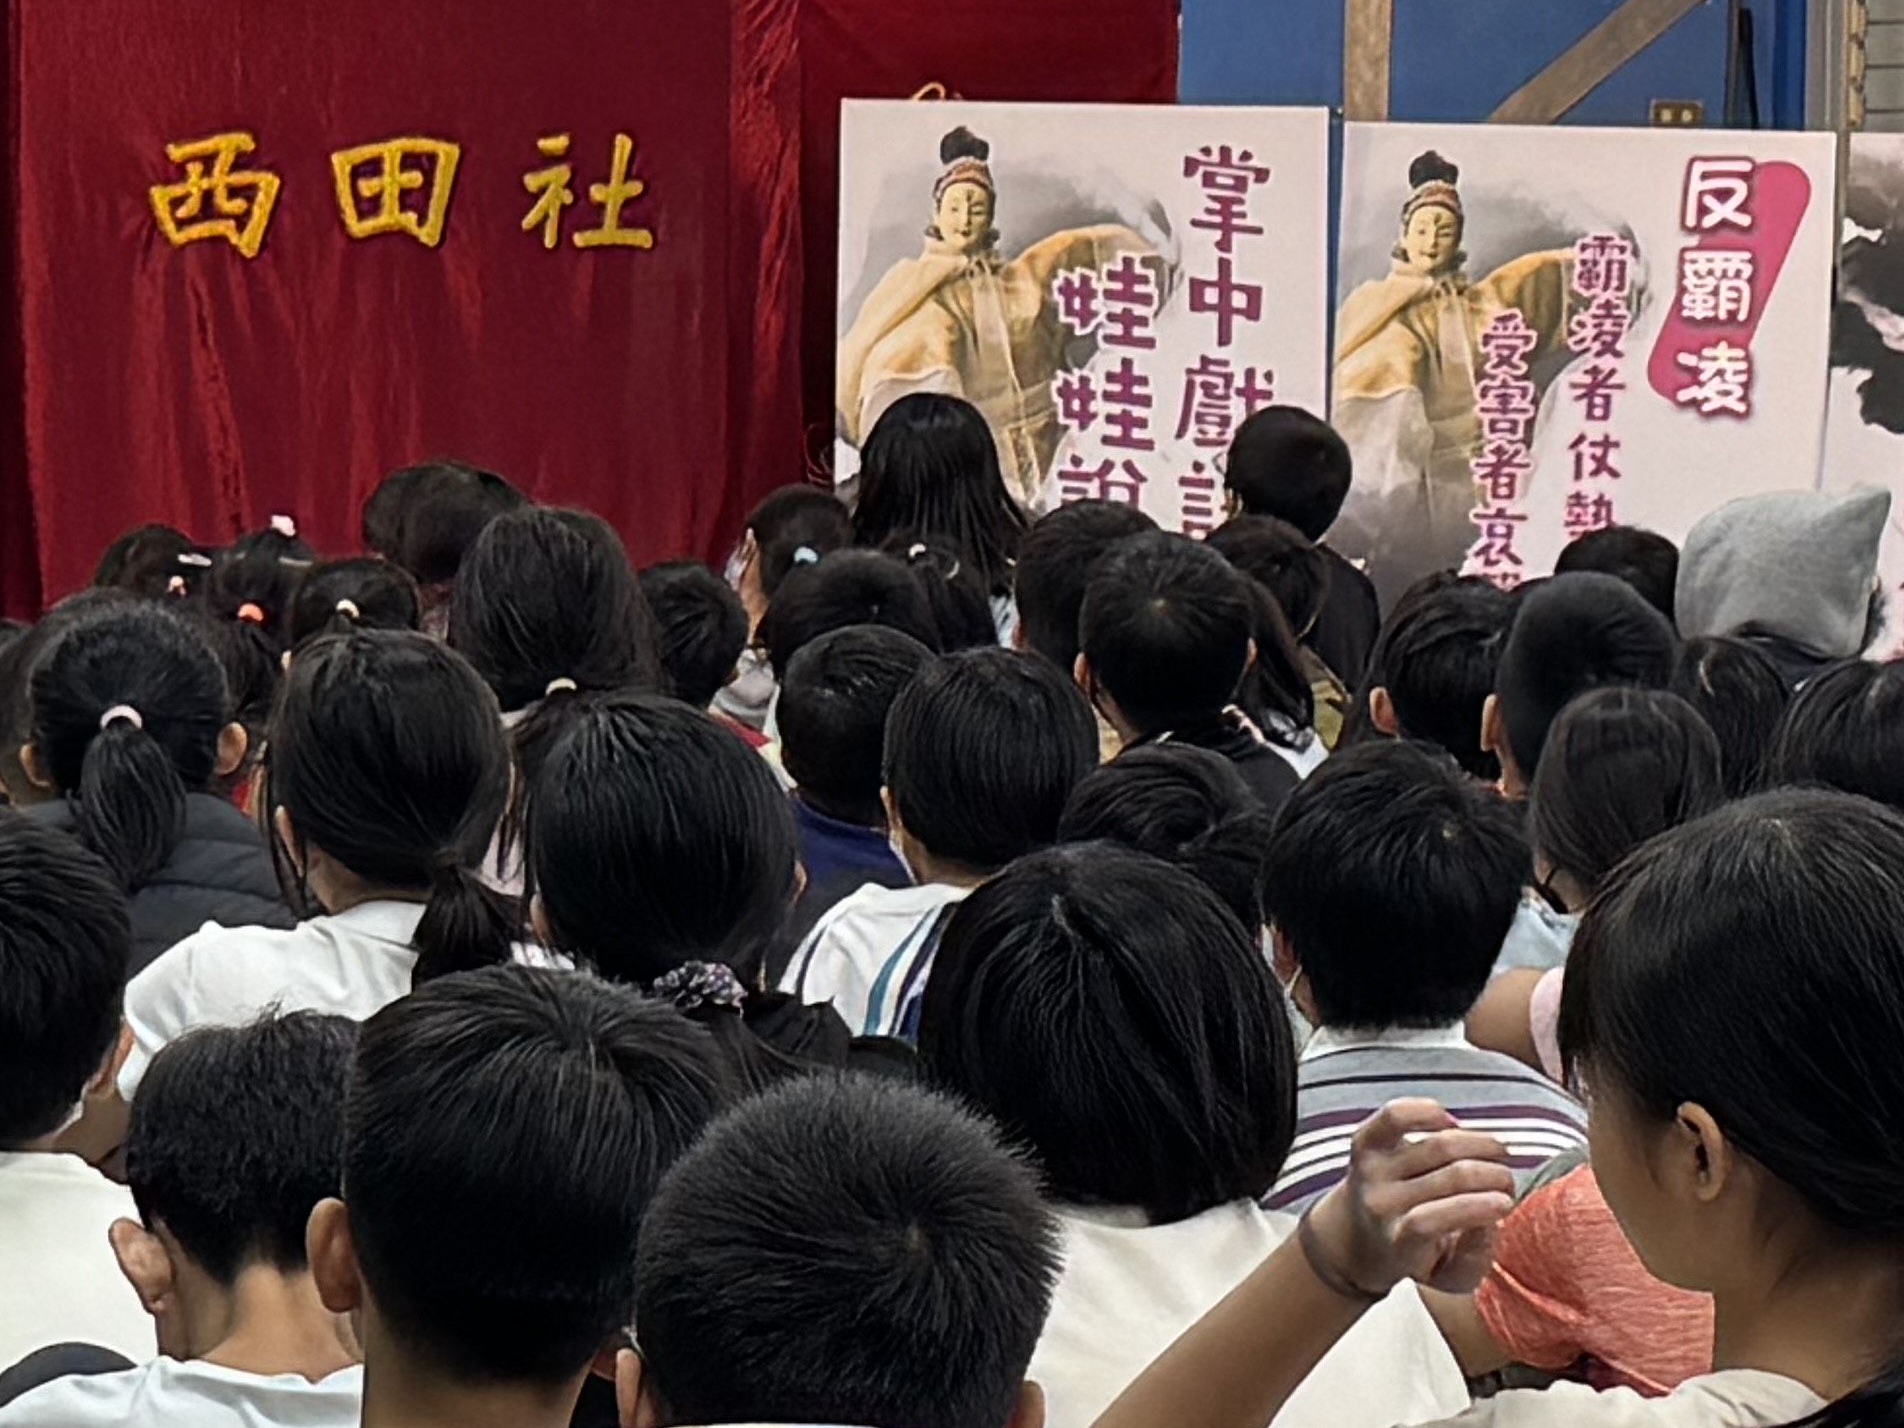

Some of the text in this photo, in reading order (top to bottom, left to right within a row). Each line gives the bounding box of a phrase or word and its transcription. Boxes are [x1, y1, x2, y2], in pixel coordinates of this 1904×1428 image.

[149, 131, 655, 259] 西田社
[1673, 156, 1756, 418] 反霸凌
